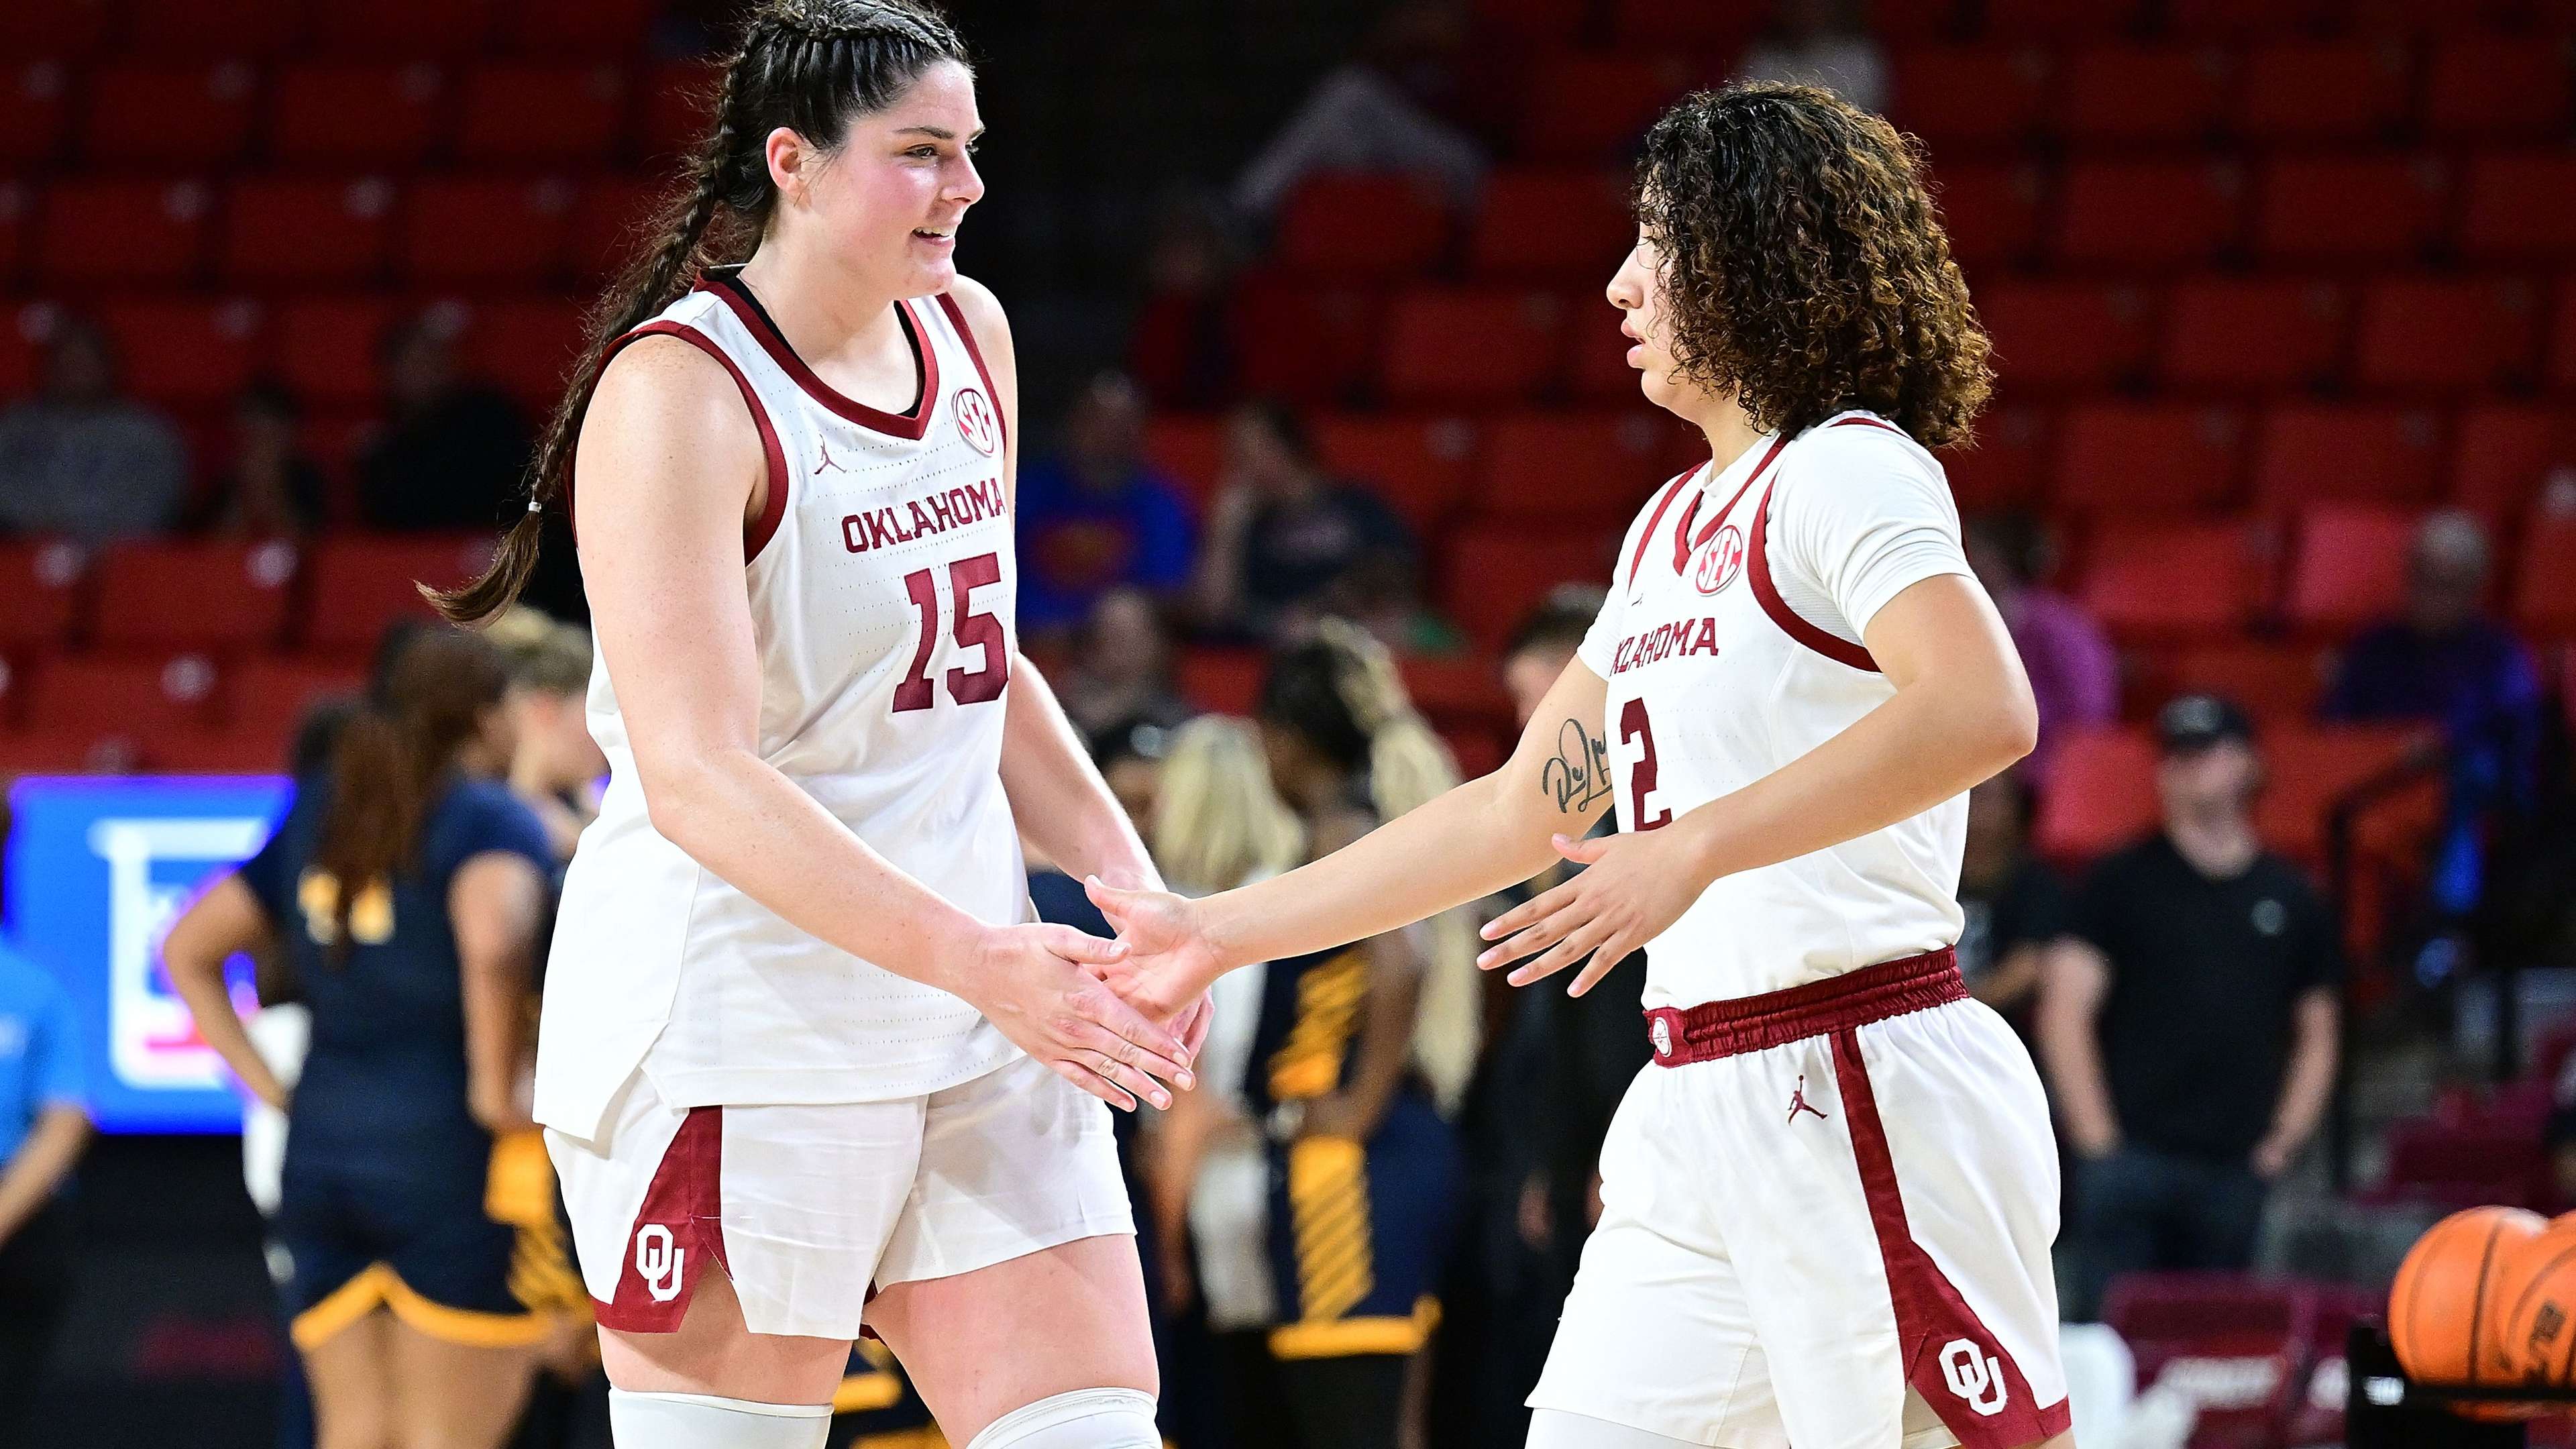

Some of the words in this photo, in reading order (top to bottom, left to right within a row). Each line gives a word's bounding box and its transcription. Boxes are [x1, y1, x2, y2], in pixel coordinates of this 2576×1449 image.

[841, 478, 1006, 553] OKLAHOMA
[1696, 527, 1743, 590] SEC
[892, 552, 1008, 712] 15
[1609, 617, 1719, 677] KLAHOMA
[1620, 697, 1672, 832] 2
[636, 1224, 685, 1301] OU
[1938, 1338, 2008, 1417] OU
